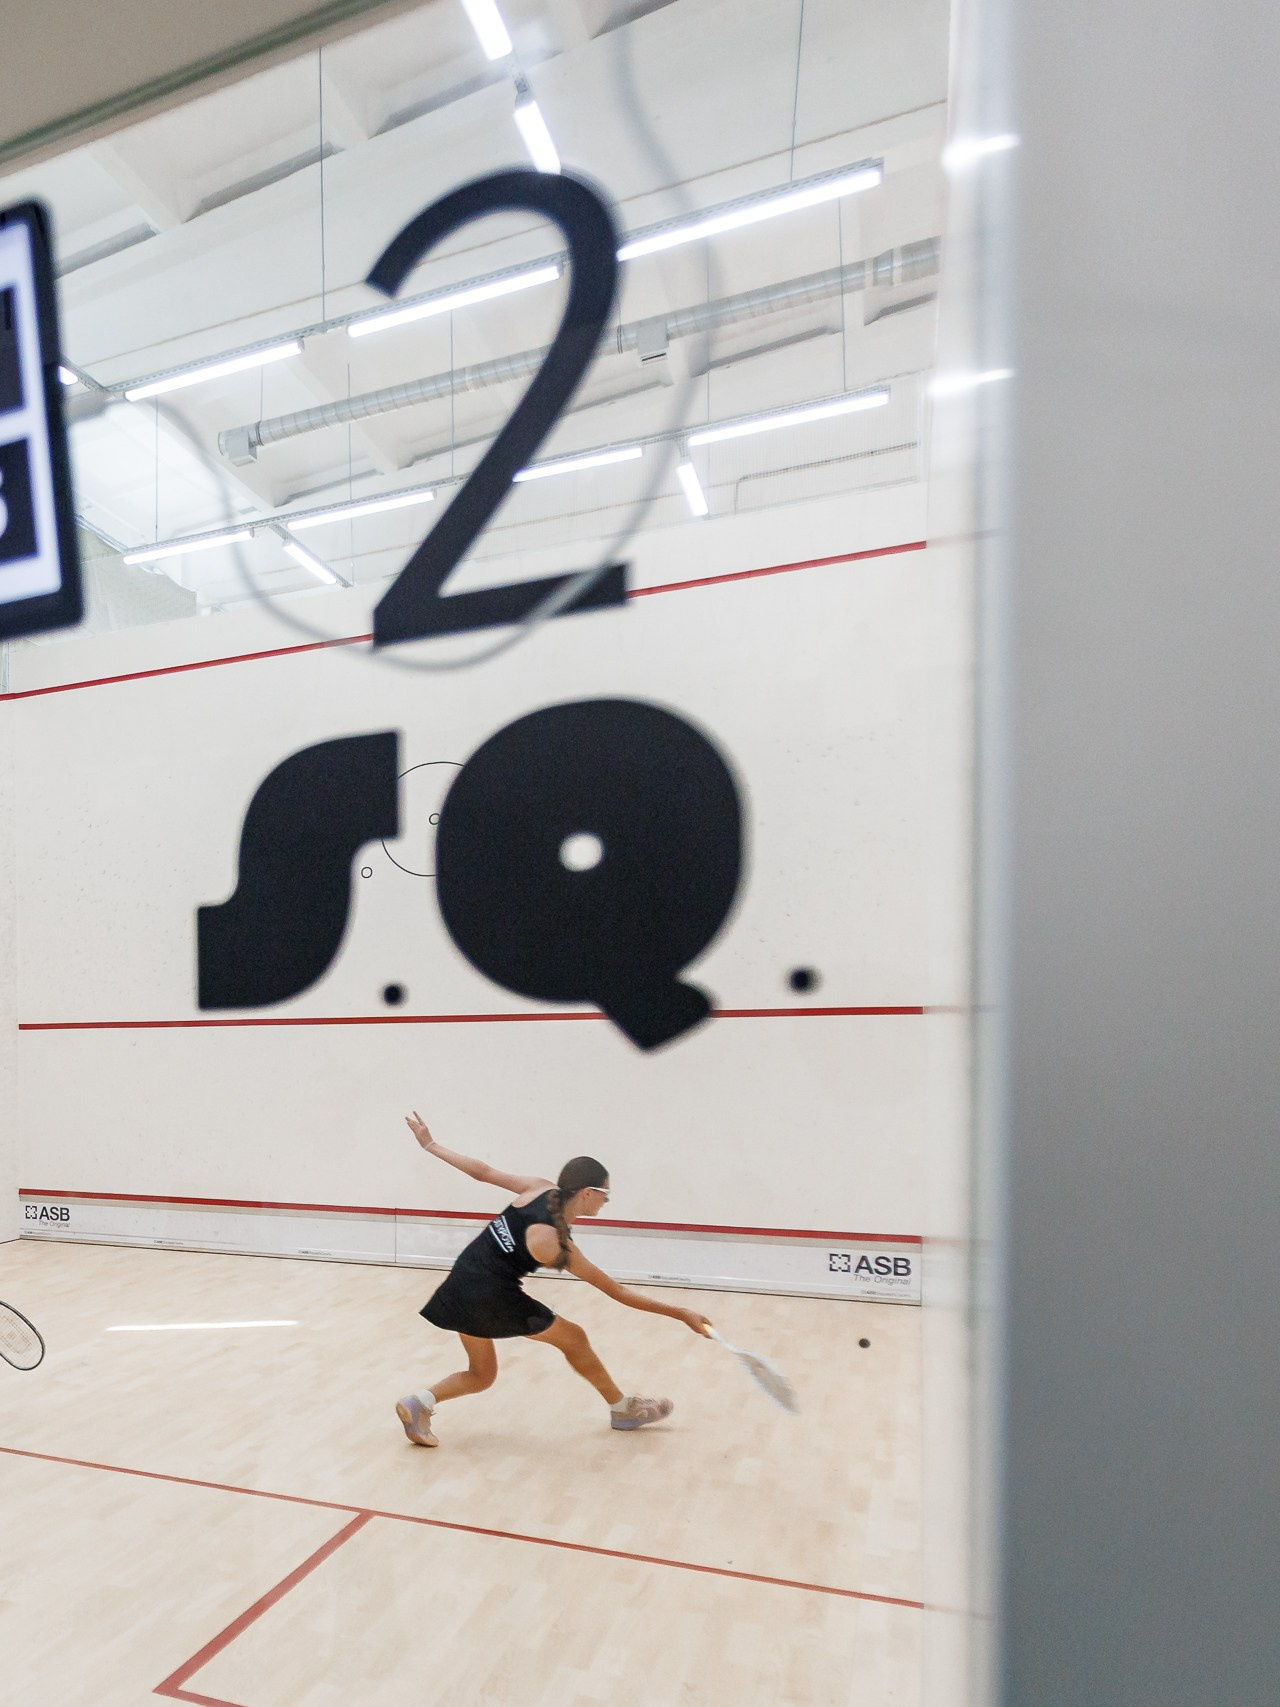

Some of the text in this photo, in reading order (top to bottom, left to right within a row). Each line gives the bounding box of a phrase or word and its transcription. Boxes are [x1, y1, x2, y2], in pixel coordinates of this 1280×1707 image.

[364, 166, 631, 650] 2
[39, 1206, 70, 1222] ASB
[854, 1255, 912, 1277] ASB
[853, 1274, 912, 1286] The Original
